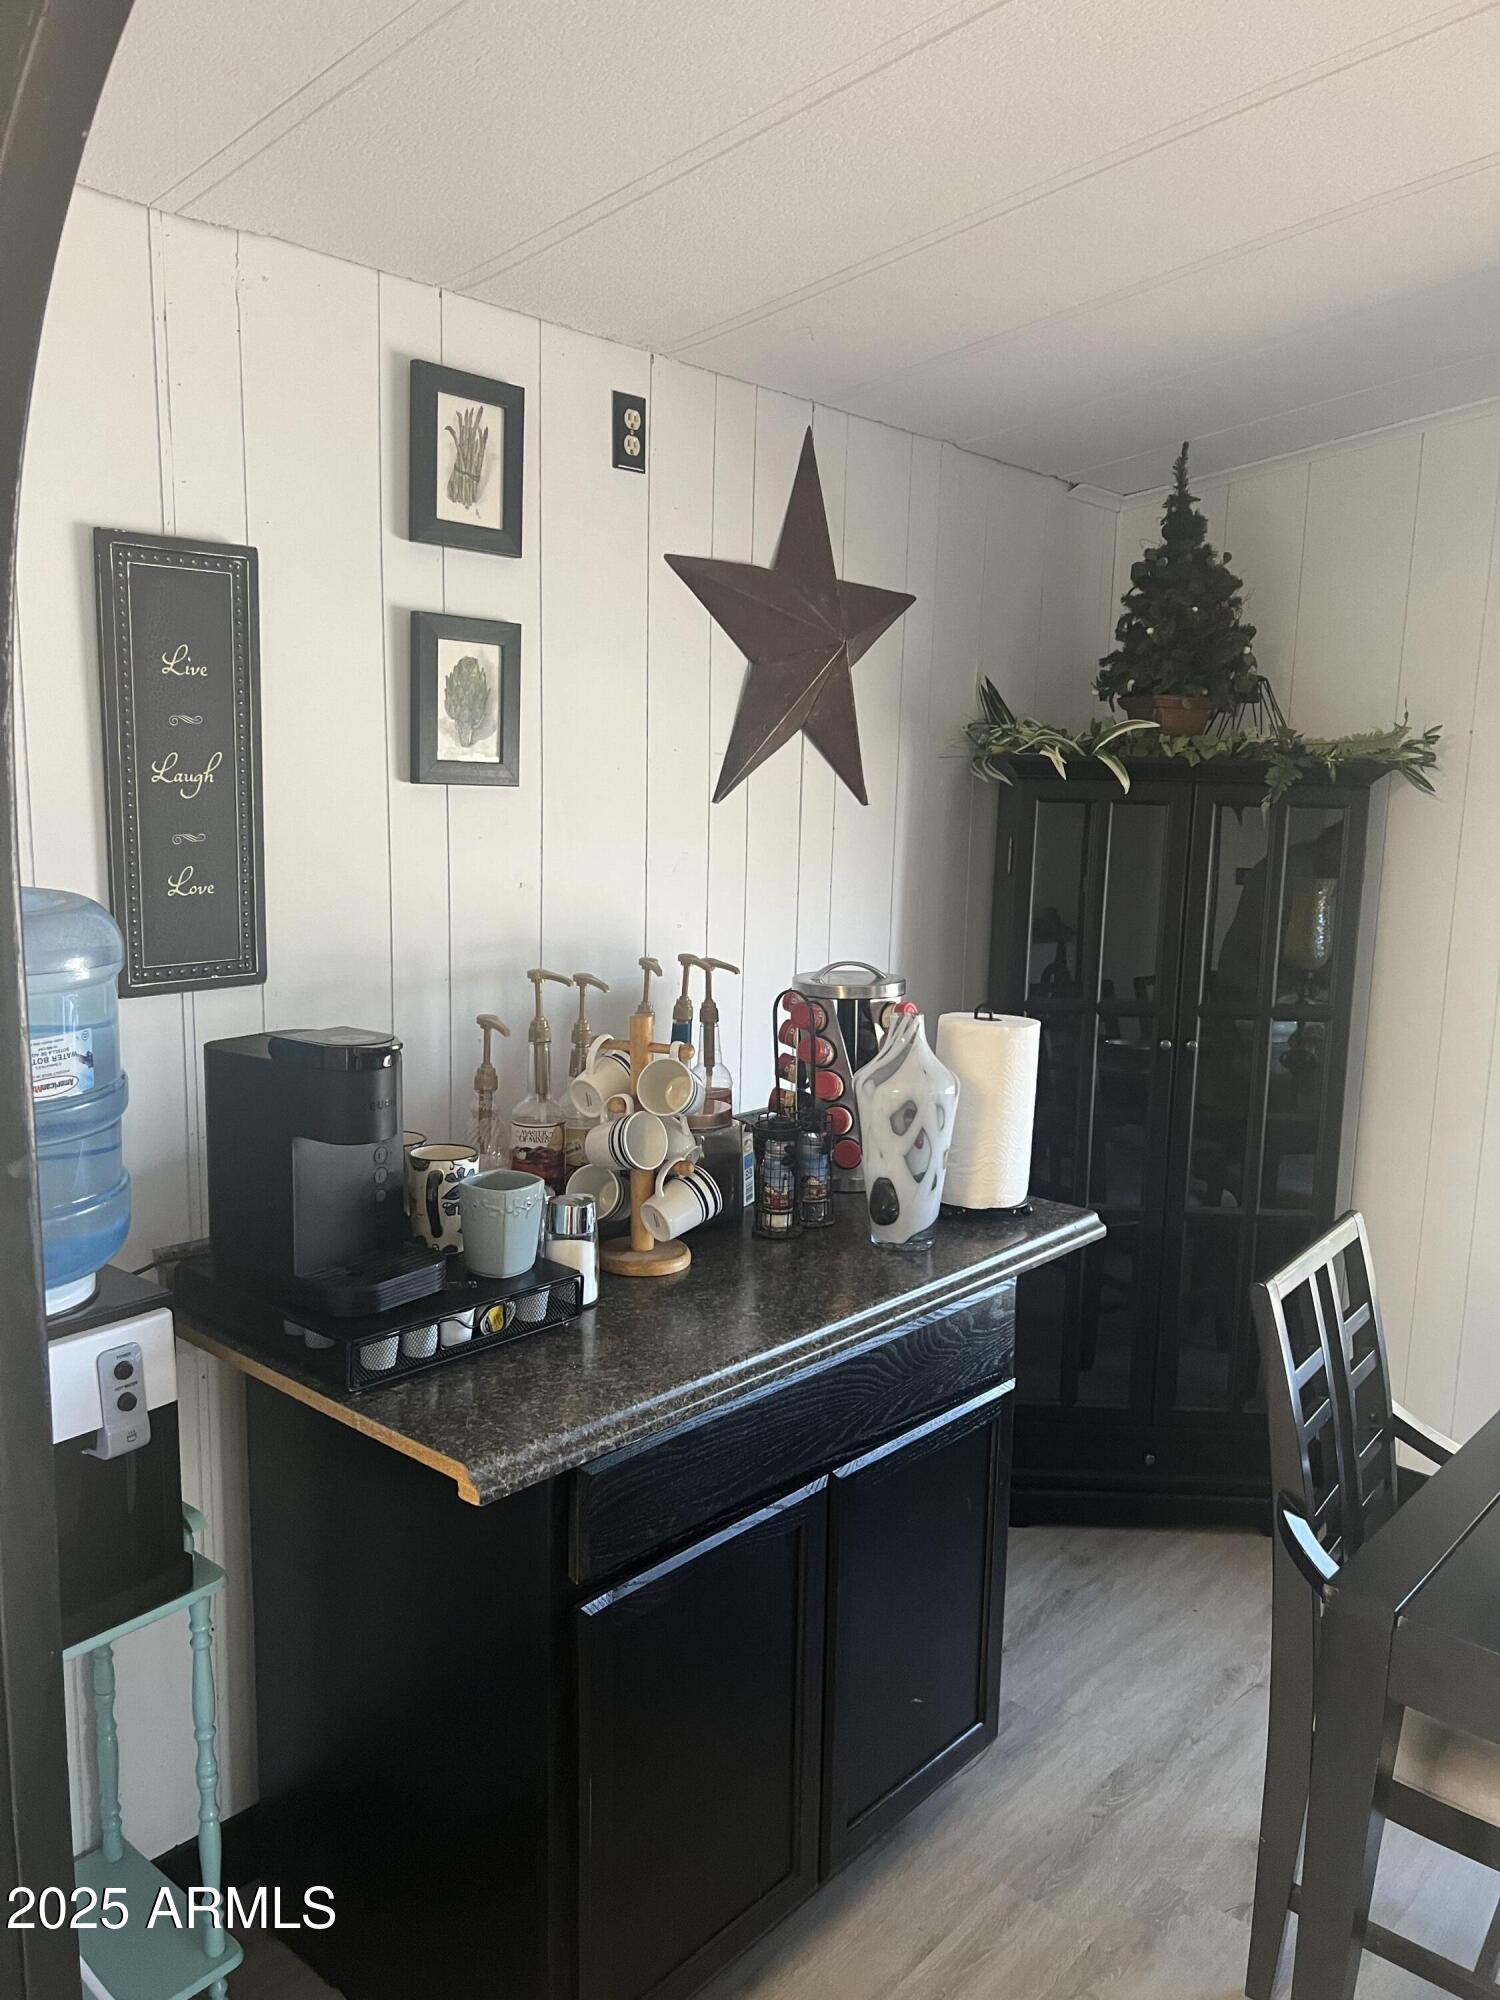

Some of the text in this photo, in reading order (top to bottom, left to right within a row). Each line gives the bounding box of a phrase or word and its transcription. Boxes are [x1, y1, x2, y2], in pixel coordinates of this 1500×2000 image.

[161, 643, 209, 677] Live
[151, 751, 223, 799] Laugh
[167, 865, 215, 898] Love
[51, 1050, 78, 1061] WATER
